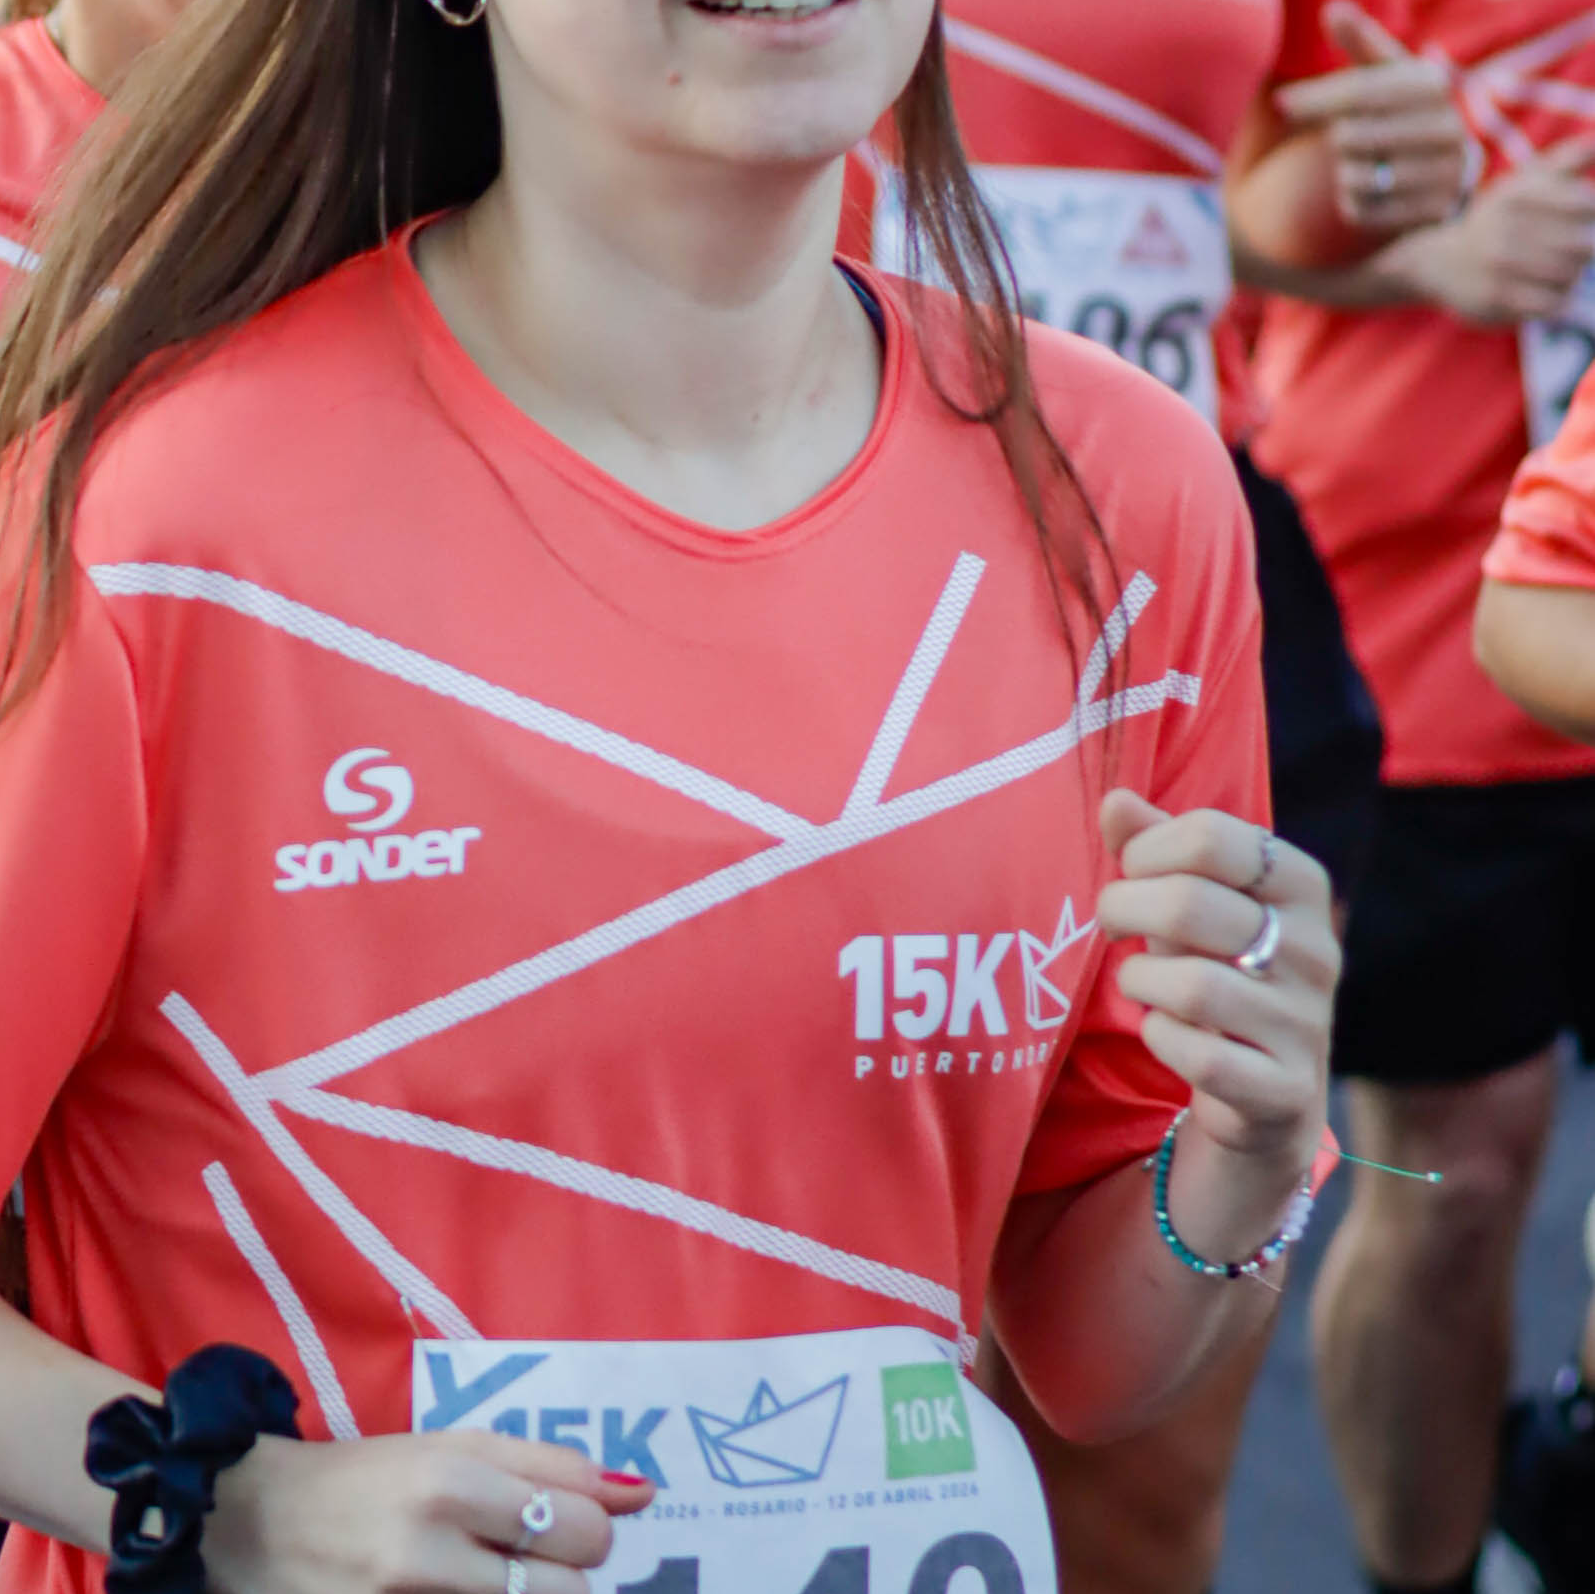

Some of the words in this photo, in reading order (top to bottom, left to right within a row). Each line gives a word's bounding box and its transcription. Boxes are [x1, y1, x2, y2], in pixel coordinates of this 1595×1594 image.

[838, 932, 1015, 1040] 15K
[855, 1050, 1005, 1079] PUERTO
[891, 1395, 963, 1447] 10K
[724, 1498, 806, 1517] ROSARIO
[854, 1491, 875, 1508] DE
[883, 1486, 934, 1504] ABRIL
